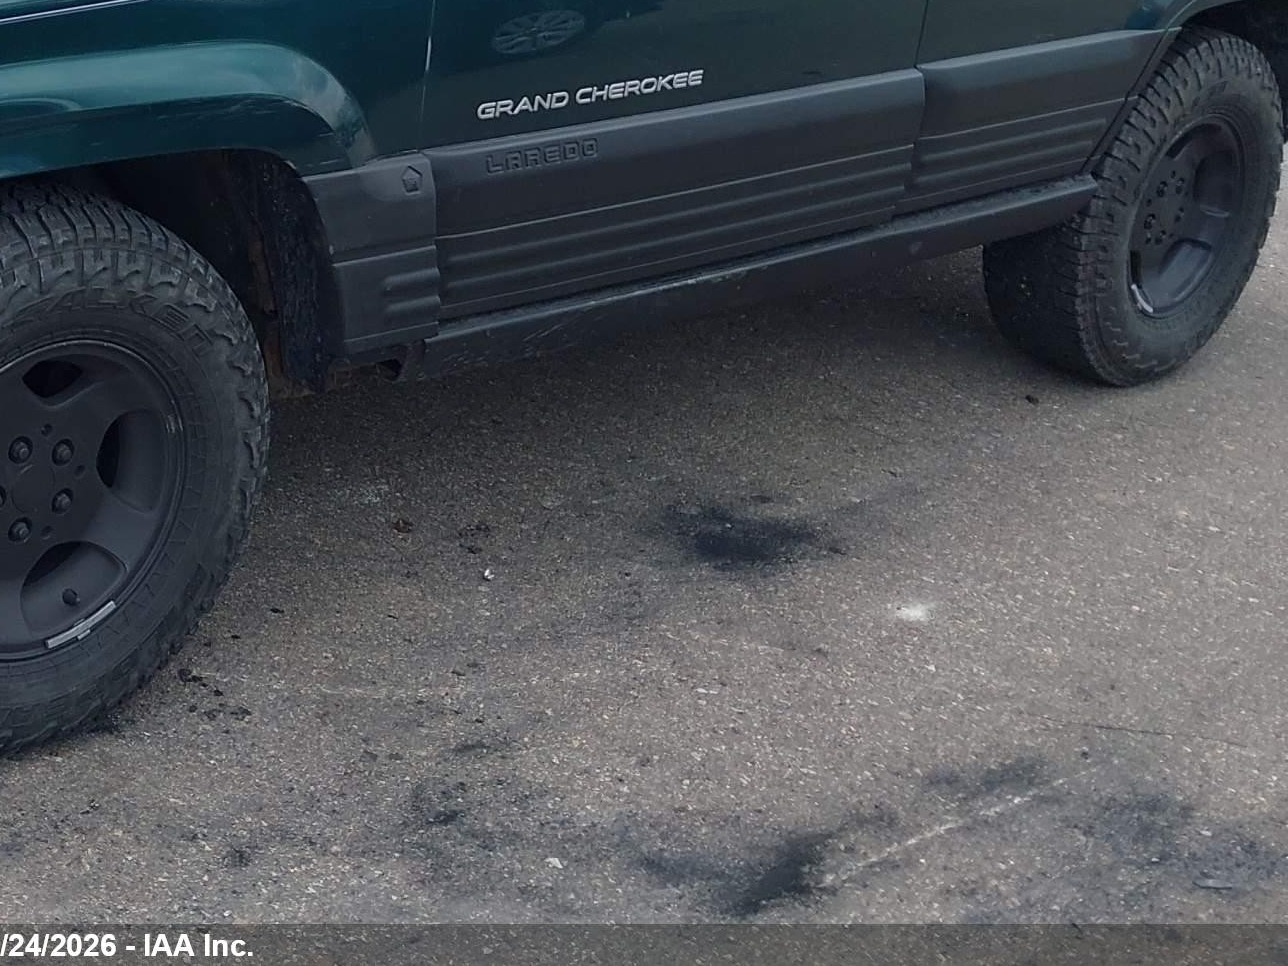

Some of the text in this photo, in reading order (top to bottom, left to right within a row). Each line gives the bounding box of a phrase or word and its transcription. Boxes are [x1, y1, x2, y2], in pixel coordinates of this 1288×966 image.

[477, 69, 705, 120] GRAND CHEROKEE
[486, 137, 600, 174] LAREDO
